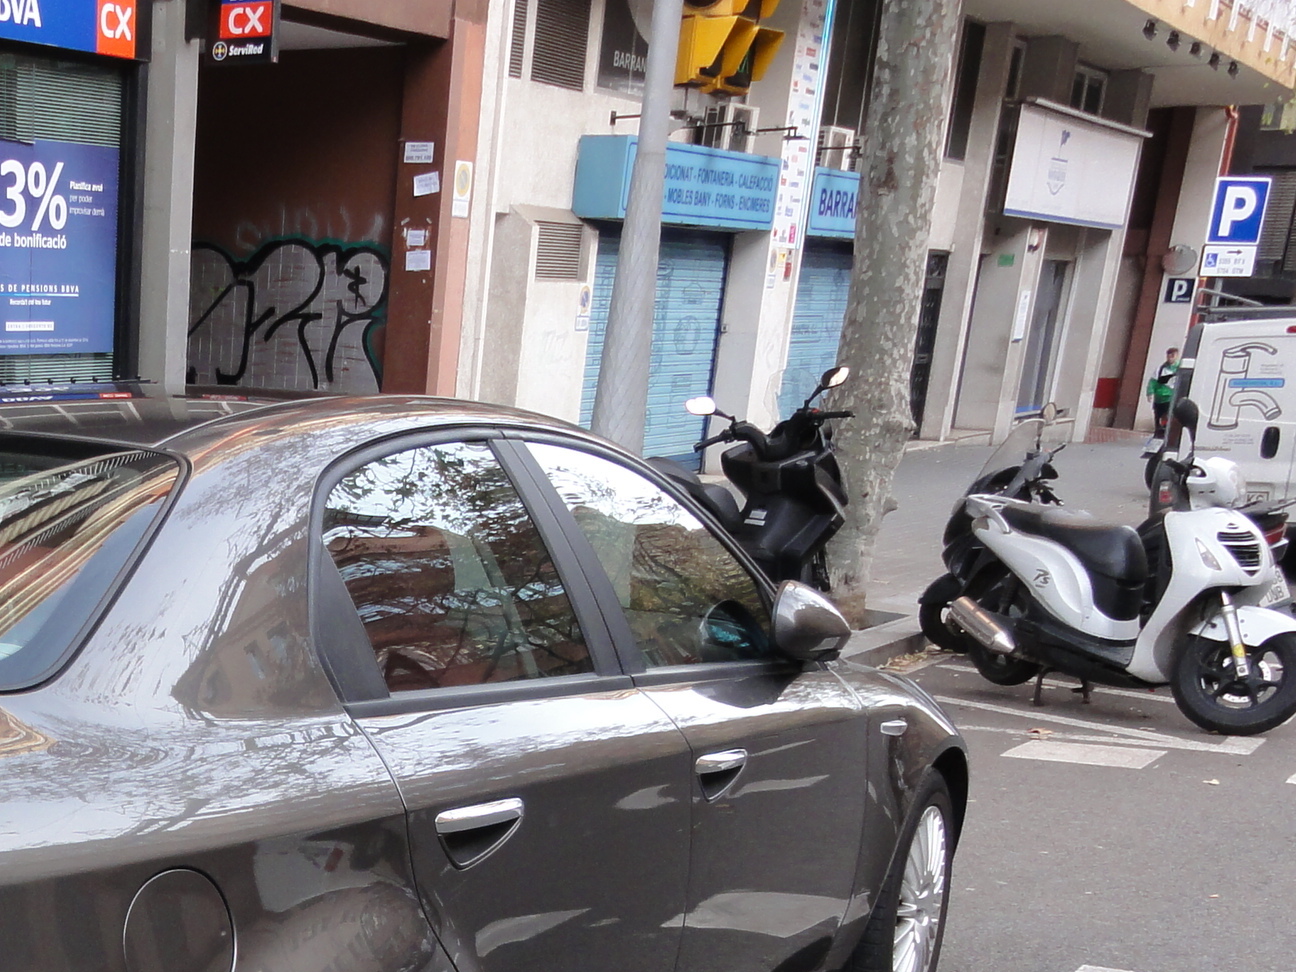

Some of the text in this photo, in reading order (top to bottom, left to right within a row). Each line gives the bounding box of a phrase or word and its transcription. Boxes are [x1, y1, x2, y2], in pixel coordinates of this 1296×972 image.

[101, 4, 132, 41] CX
[228, 6, 264, 35] CX
[229, 44, 263, 57] ServiRed
[70, 181, 92, 191] Planifica
[697, 168, 734, 187] FONTANERIA
[738, 174, 773, 192] CALEFACCIÓ
[667, 188, 693, 205] MOBLES
[694, 191, 712, 206] BANY
[715, 193, 735, 209] FORNS
[1218, 186, 1256, 237] P
[0, 232, 67, 249] de bonificació
[8, 284, 17, 292] DE
[21, 284, 58, 293] PENSIONS
[61, 285, 79, 293] BBVA
[1171, 280, 1188, 301] P
